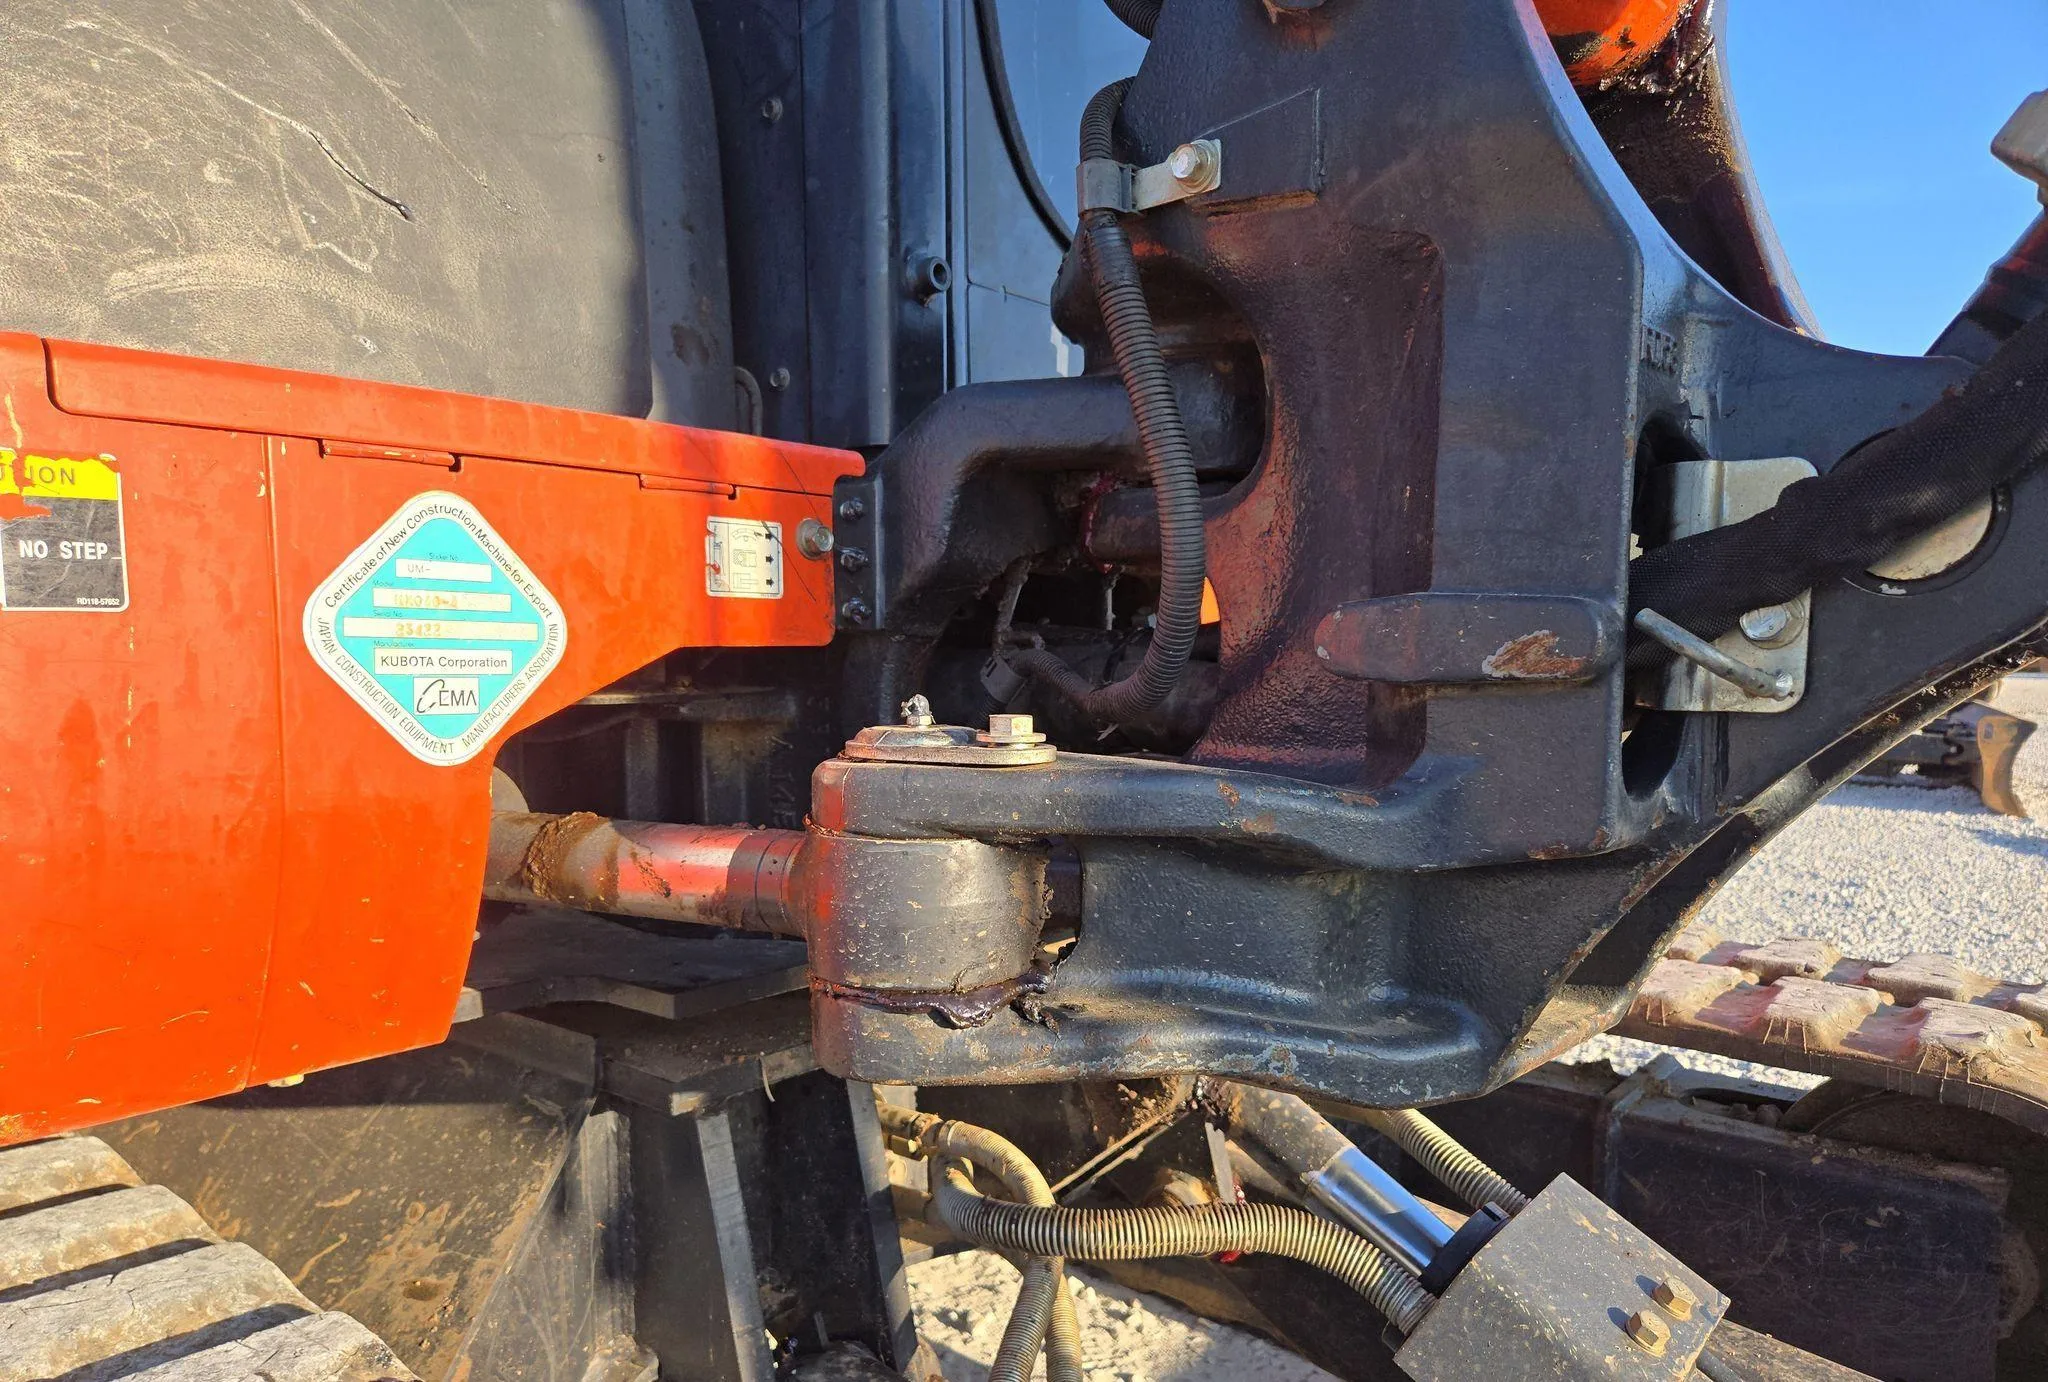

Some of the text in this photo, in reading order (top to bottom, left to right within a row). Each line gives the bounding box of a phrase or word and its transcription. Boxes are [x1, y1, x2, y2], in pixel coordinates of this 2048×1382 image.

[0, 465, 75, 486] ION
[18, 540, 108, 560] NO STEP
[324, 504, 553, 618] Certificate of New Construction Machine for Export
[380, 655, 507, 669] KUBOTA Corporation
[317, 617, 559, 754] JAPAN CONSTRUCTION EQUIPMENT MANUFACTURERS ASSOCIATION
